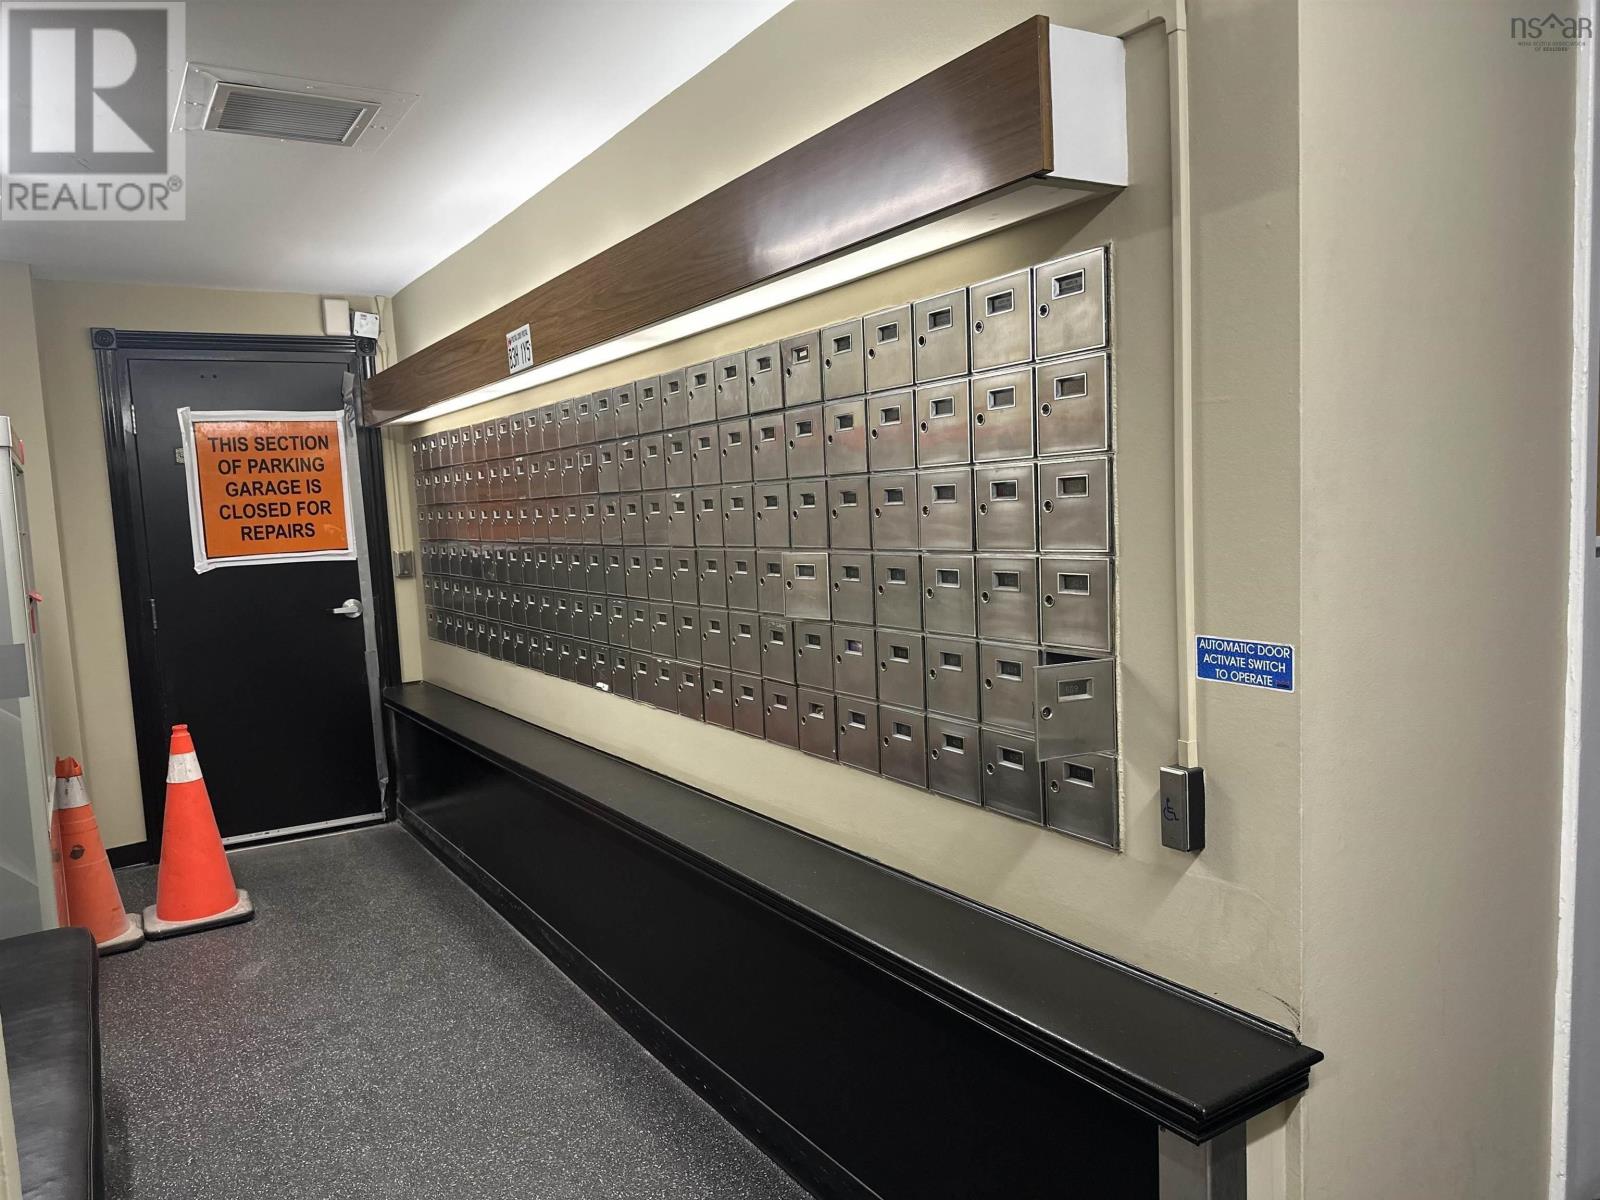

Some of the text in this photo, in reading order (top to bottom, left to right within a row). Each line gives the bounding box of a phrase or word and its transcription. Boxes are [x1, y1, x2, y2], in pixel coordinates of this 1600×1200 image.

[208, 435, 329, 453] THIS SECTION
[218, 457, 325, 475] OF PARKING
[225, 479, 322, 497] GARAGE IS
[219, 500, 332, 520] CLOSED FOR
[241, 522, 316, 541] REPAIRS
[1199, 639, 1290, 659] AUTOMATIC DOOR
[1203, 653, 1286, 673] ACTIVATE SWITCH
[1215, 668, 1228, 680] TO
[1230, 671, 1273, 687] OPERATE
